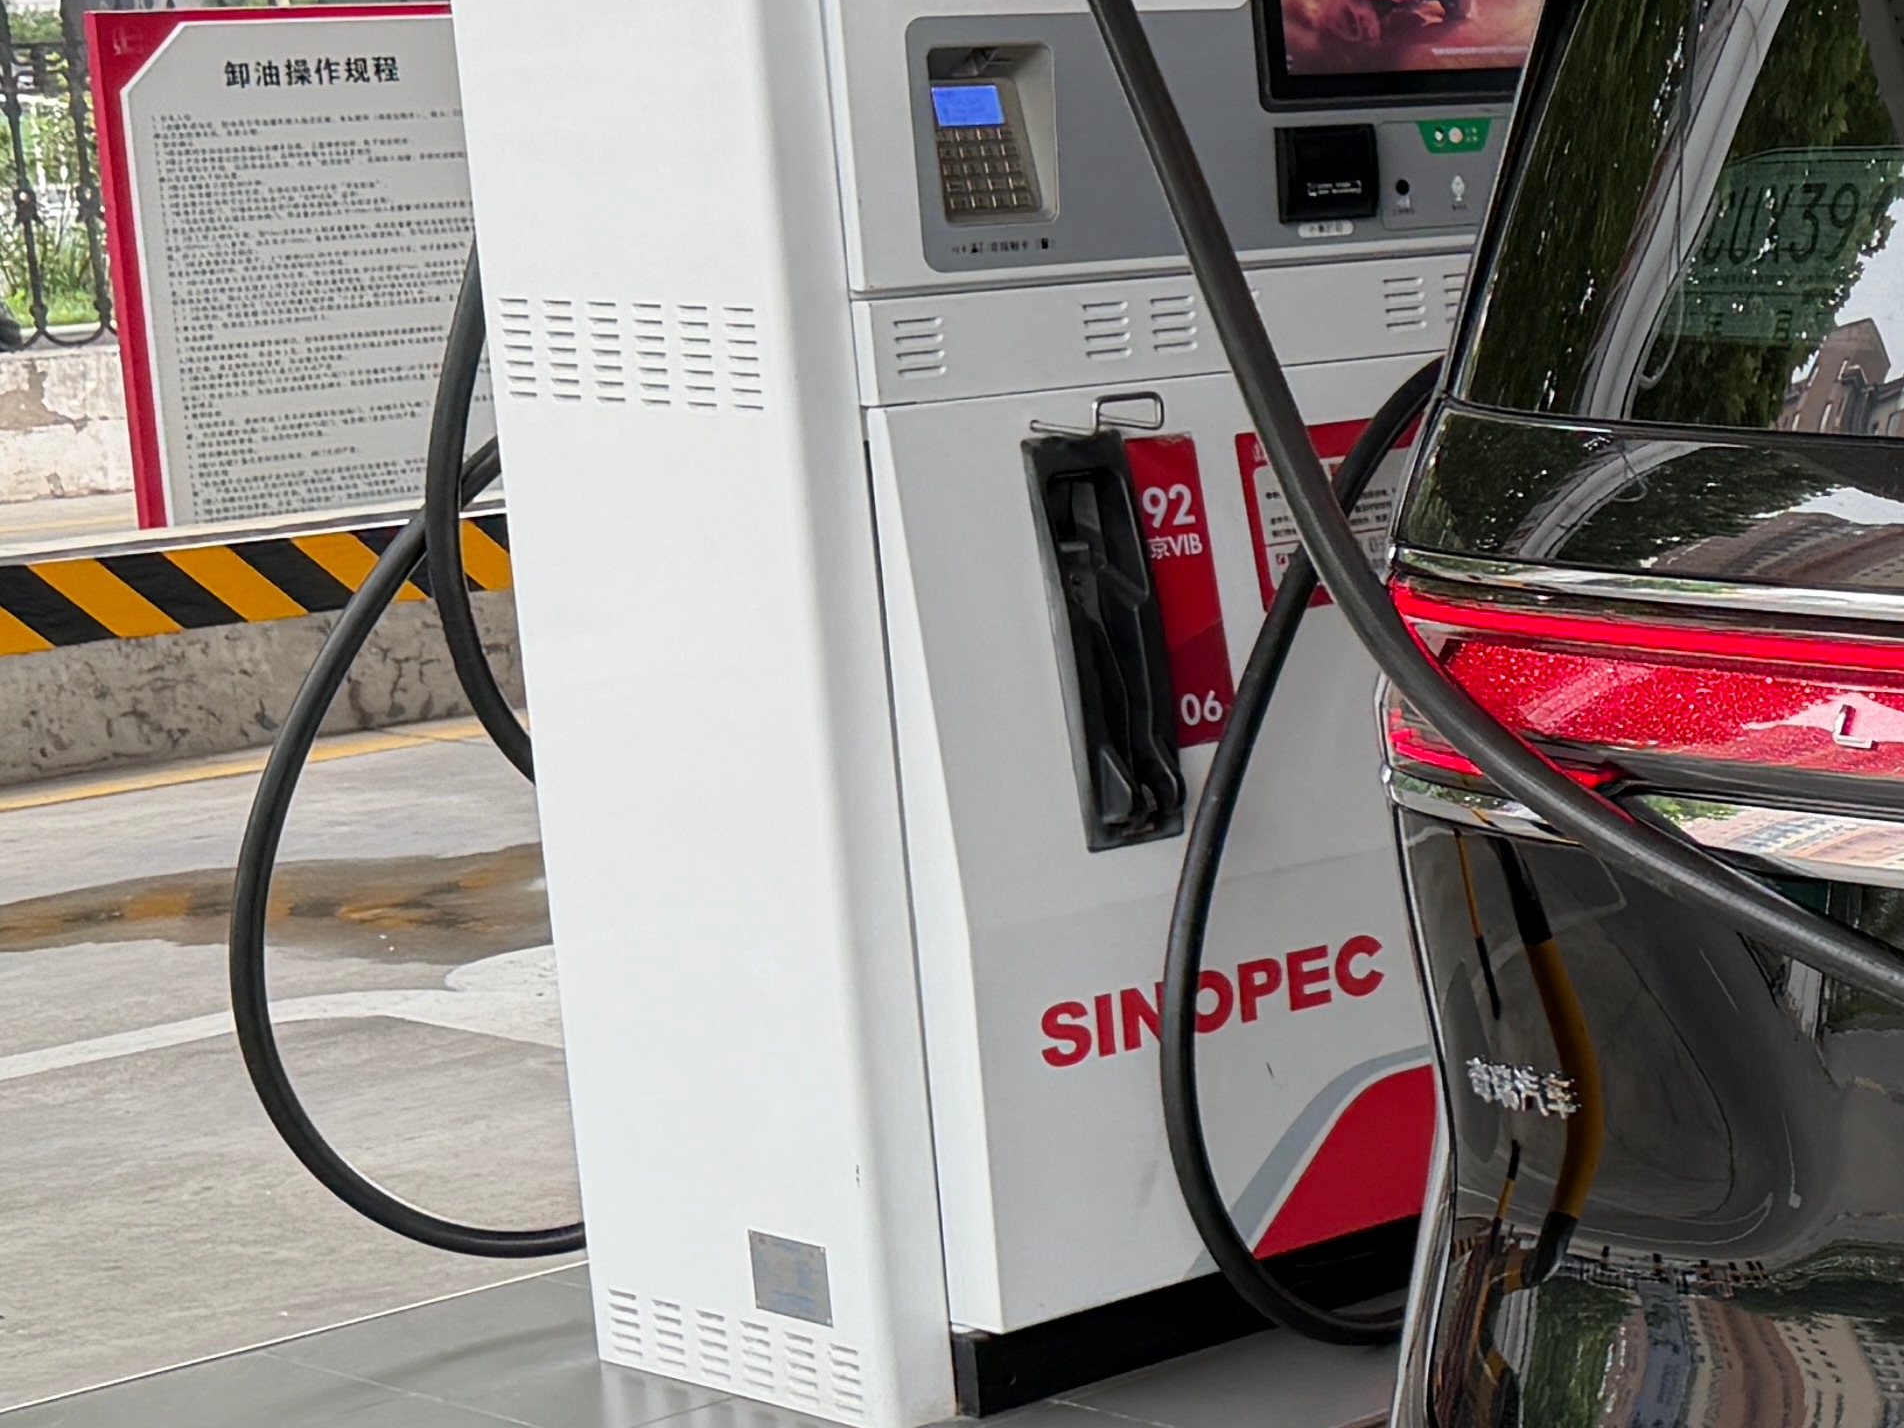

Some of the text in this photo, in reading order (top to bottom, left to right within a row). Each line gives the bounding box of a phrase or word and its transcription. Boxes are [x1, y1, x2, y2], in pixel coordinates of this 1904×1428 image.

[223, 55, 401, 90] 卸油操作规程
[1142, 483, 1197, 529] 92
[1148, 534, 1204, 560] 京VIB
[1180, 689, 1224, 727] 06
[1040, 933, 1385, 1068] SINOPEC
